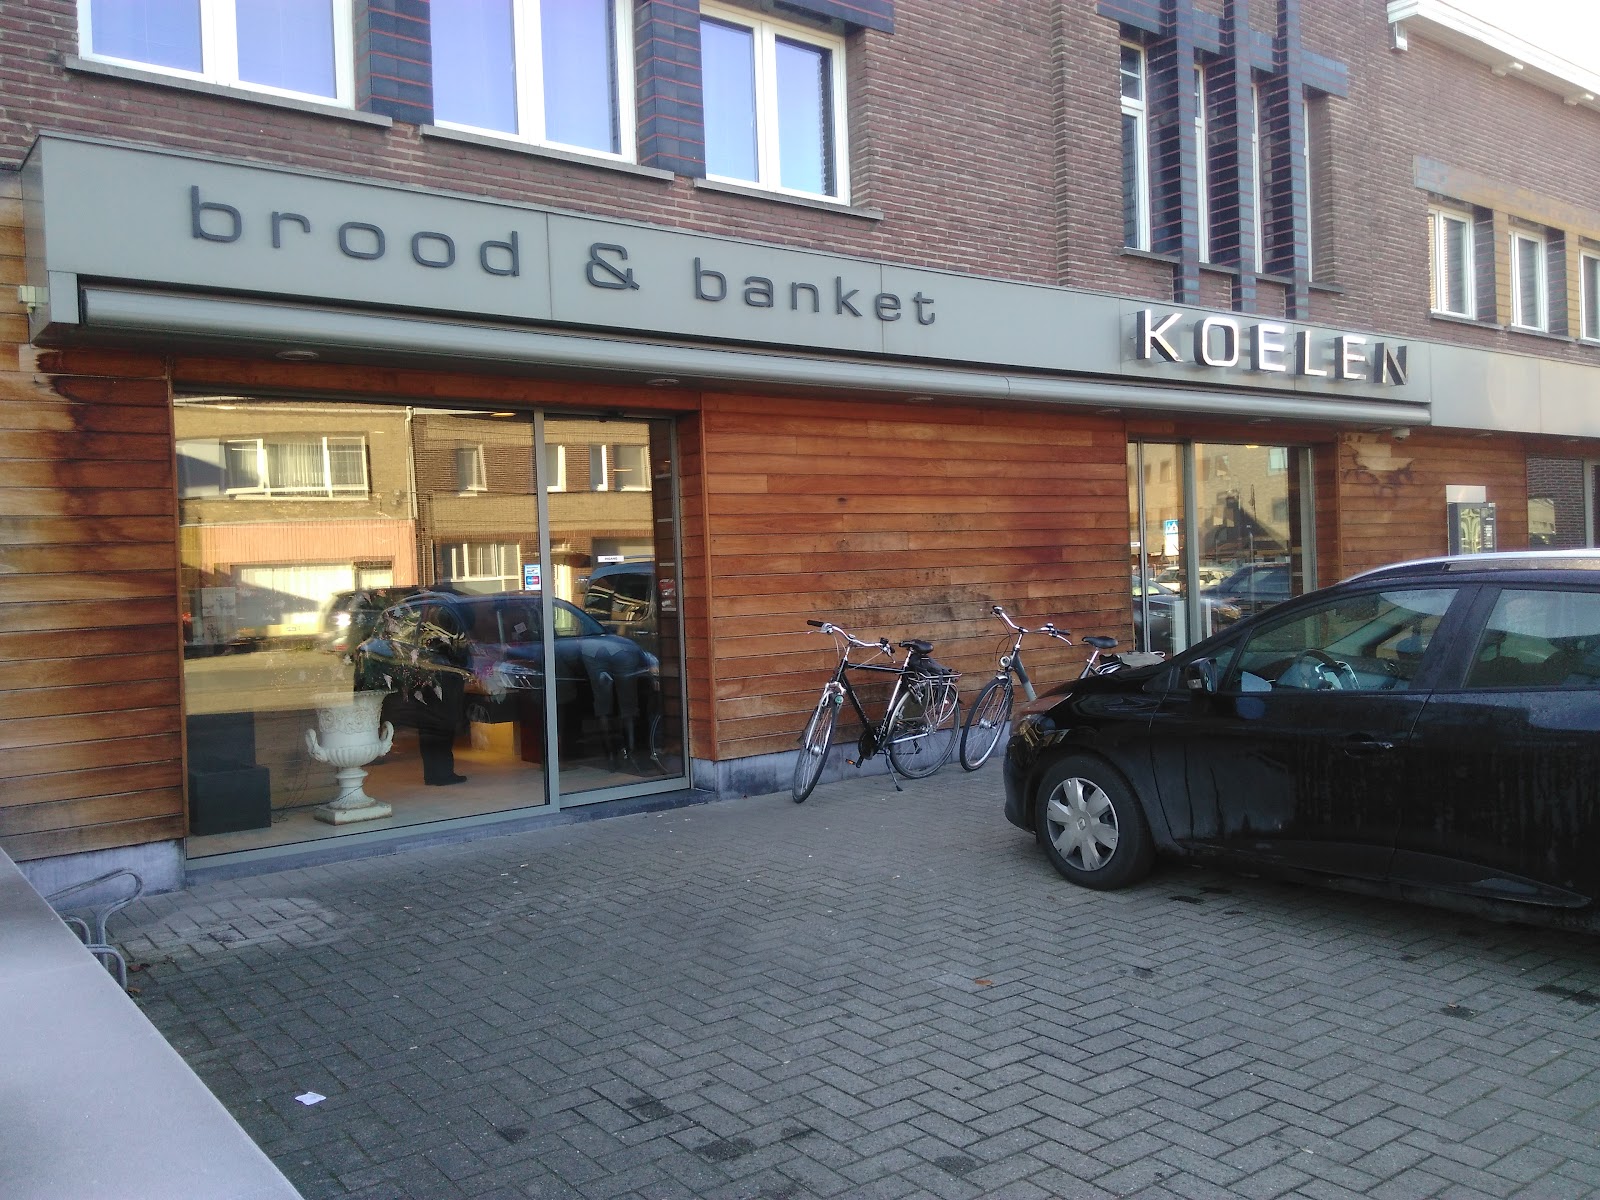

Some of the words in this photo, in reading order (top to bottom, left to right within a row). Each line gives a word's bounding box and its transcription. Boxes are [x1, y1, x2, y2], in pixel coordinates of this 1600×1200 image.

[190, 184, 521, 277] brood
[585, 242, 641, 290] &
[693, 256, 936, 326] banket
[1135, 308, 1409, 386] KOELEN
